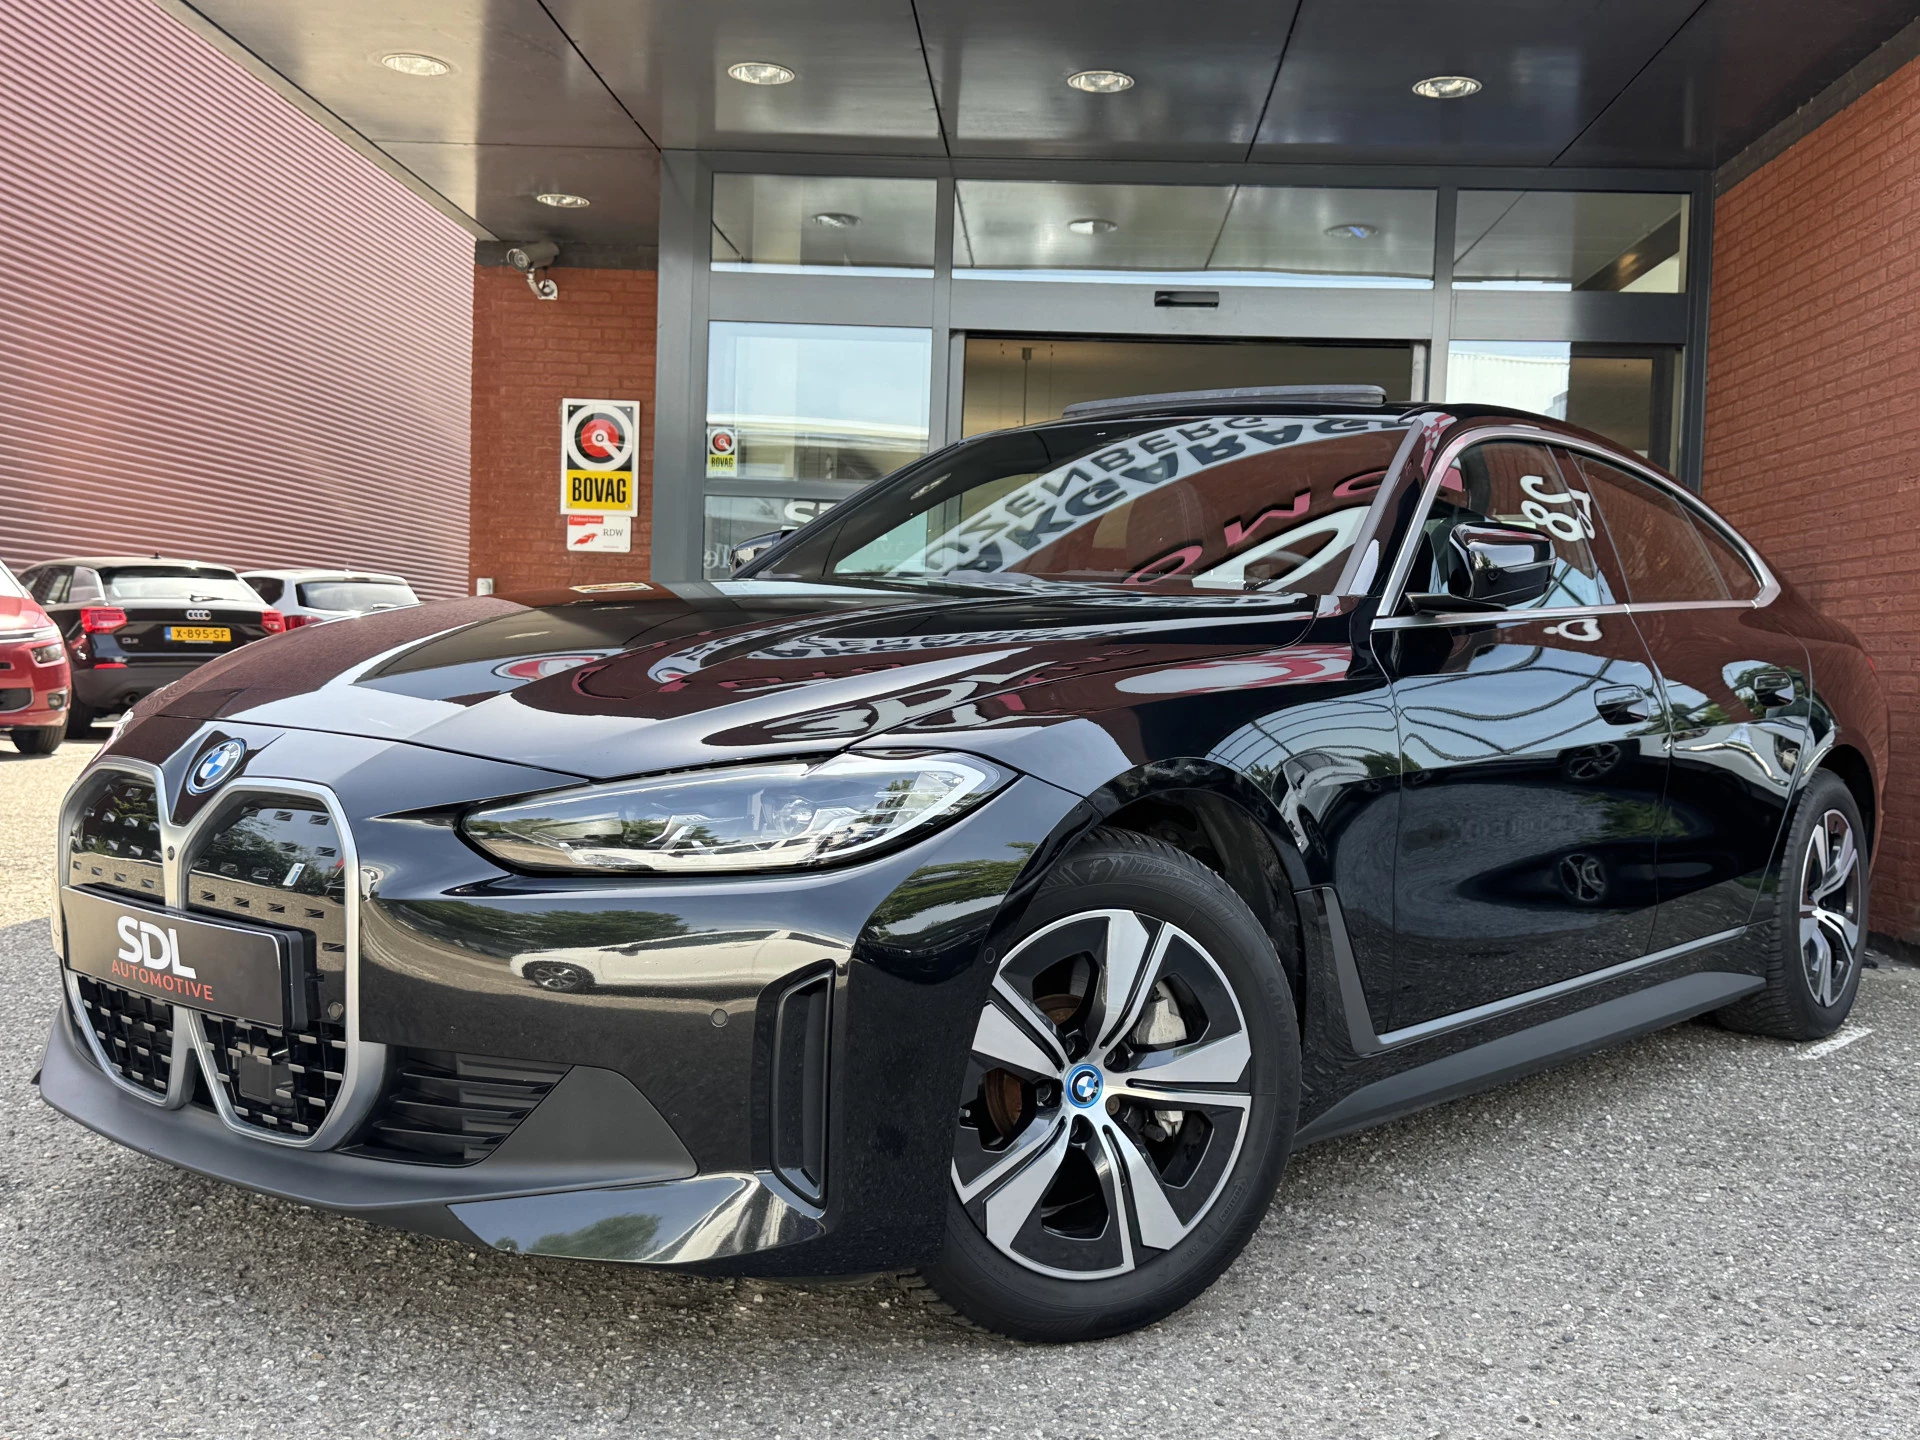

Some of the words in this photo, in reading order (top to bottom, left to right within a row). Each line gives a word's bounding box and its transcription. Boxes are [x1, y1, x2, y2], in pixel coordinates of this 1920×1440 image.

[711, 456, 734, 468] BOVAG
[572, 477, 627, 504] BOVAG
[603, 528, 624, 537] RDW
[176, 629, 227, 639] X-895-SF
[117, 915, 197, 980] SDL
[111, 959, 214, 1001] AUTOMOTIVE
